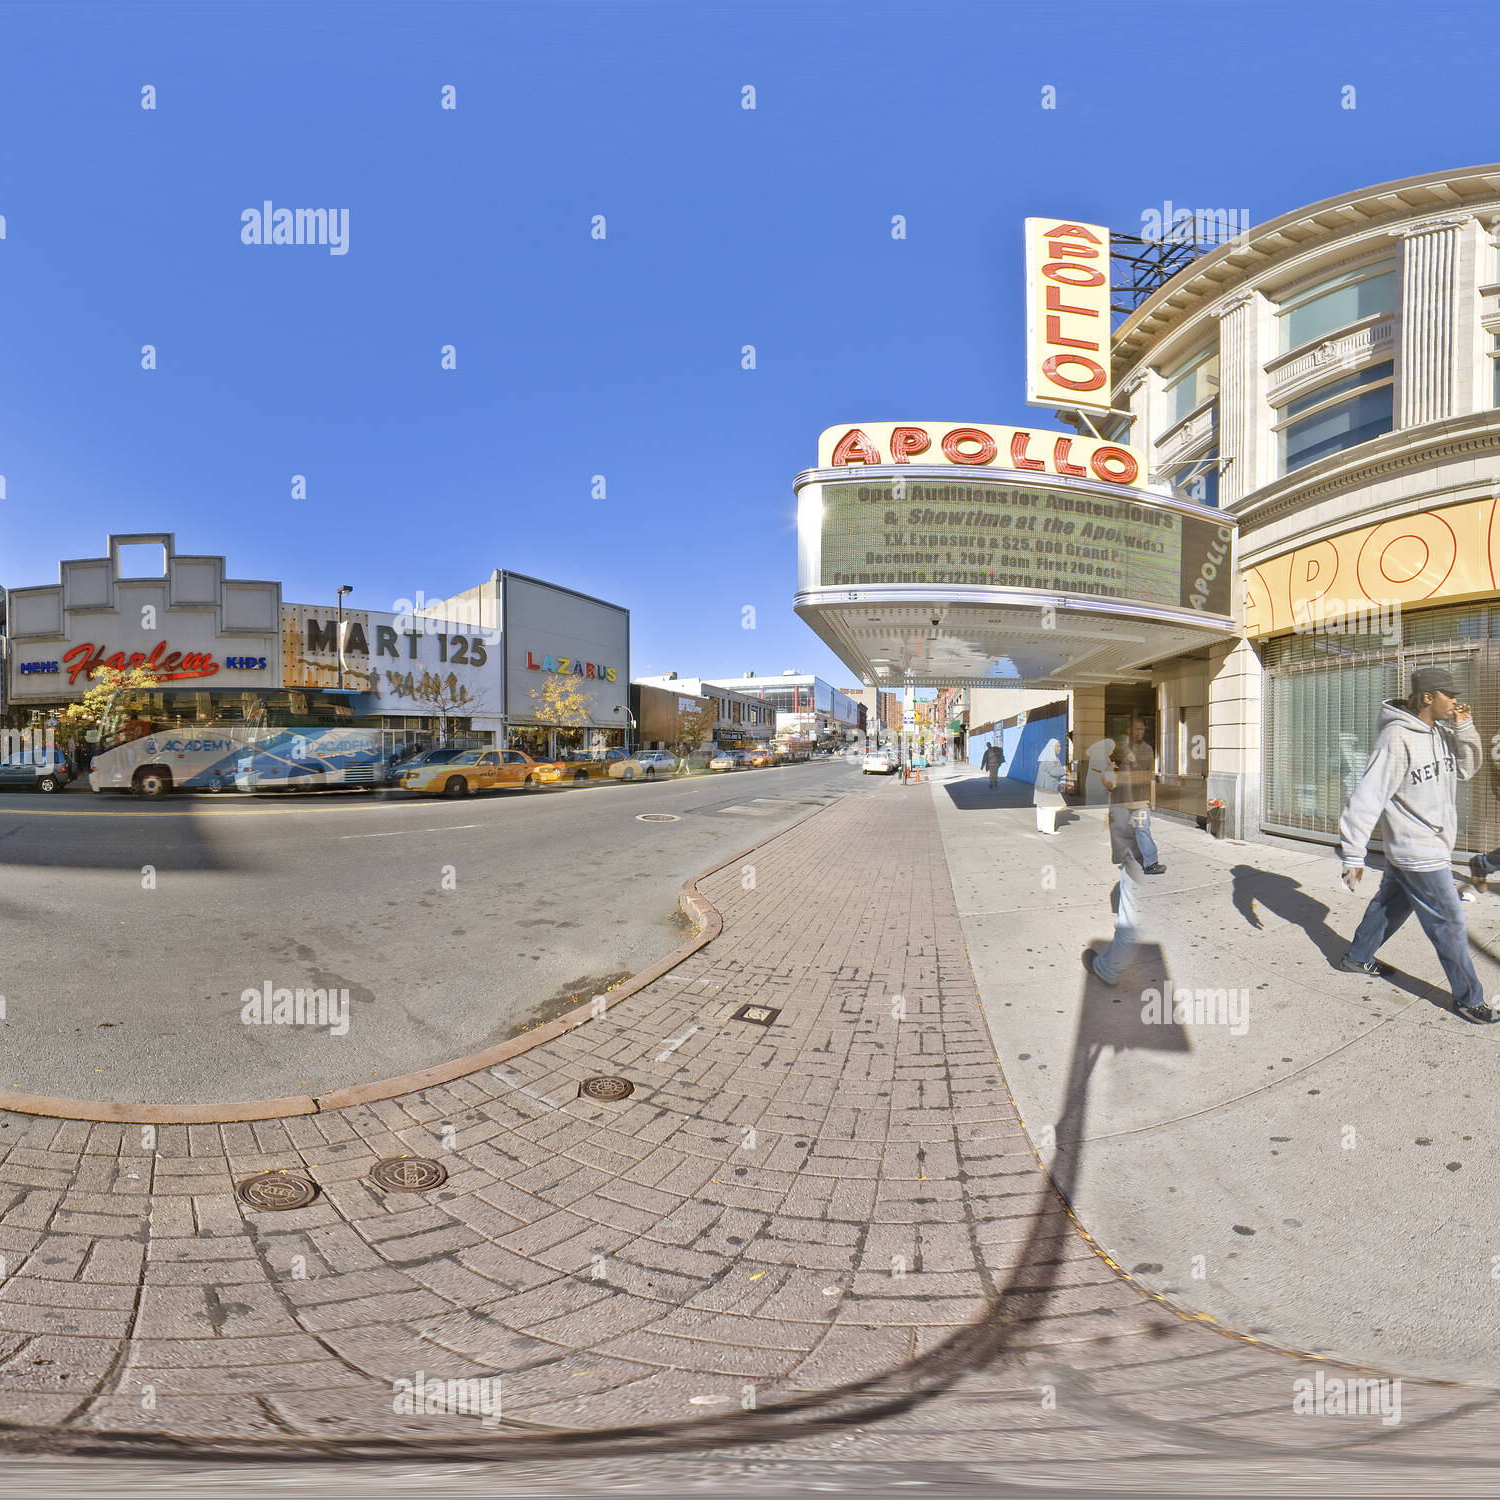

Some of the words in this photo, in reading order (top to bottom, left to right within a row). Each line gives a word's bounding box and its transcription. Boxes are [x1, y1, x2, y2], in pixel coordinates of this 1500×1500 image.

[1041, 223, 1107, 392] APOLLO
[831, 426, 1139, 486] APOLLO
[912, 485, 1008, 504] Auditions
[1012, 489, 1039, 508] for
[907, 508, 1013, 529] Showtime
[1015, 514, 1038, 531] at
[1043, 516, 1076, 535] the
[1189, 526, 1233, 611] APOLLO
[20, 660, 59, 675] MENS
[63, 640, 220, 685] Harlem
[226, 656, 267, 670] KIDS
[307, 618, 423, 660] MART
[436, 632, 488, 668] 125
[527, 650, 618, 683] LAZARUS
[161, 739, 233, 752] ACADEMY
